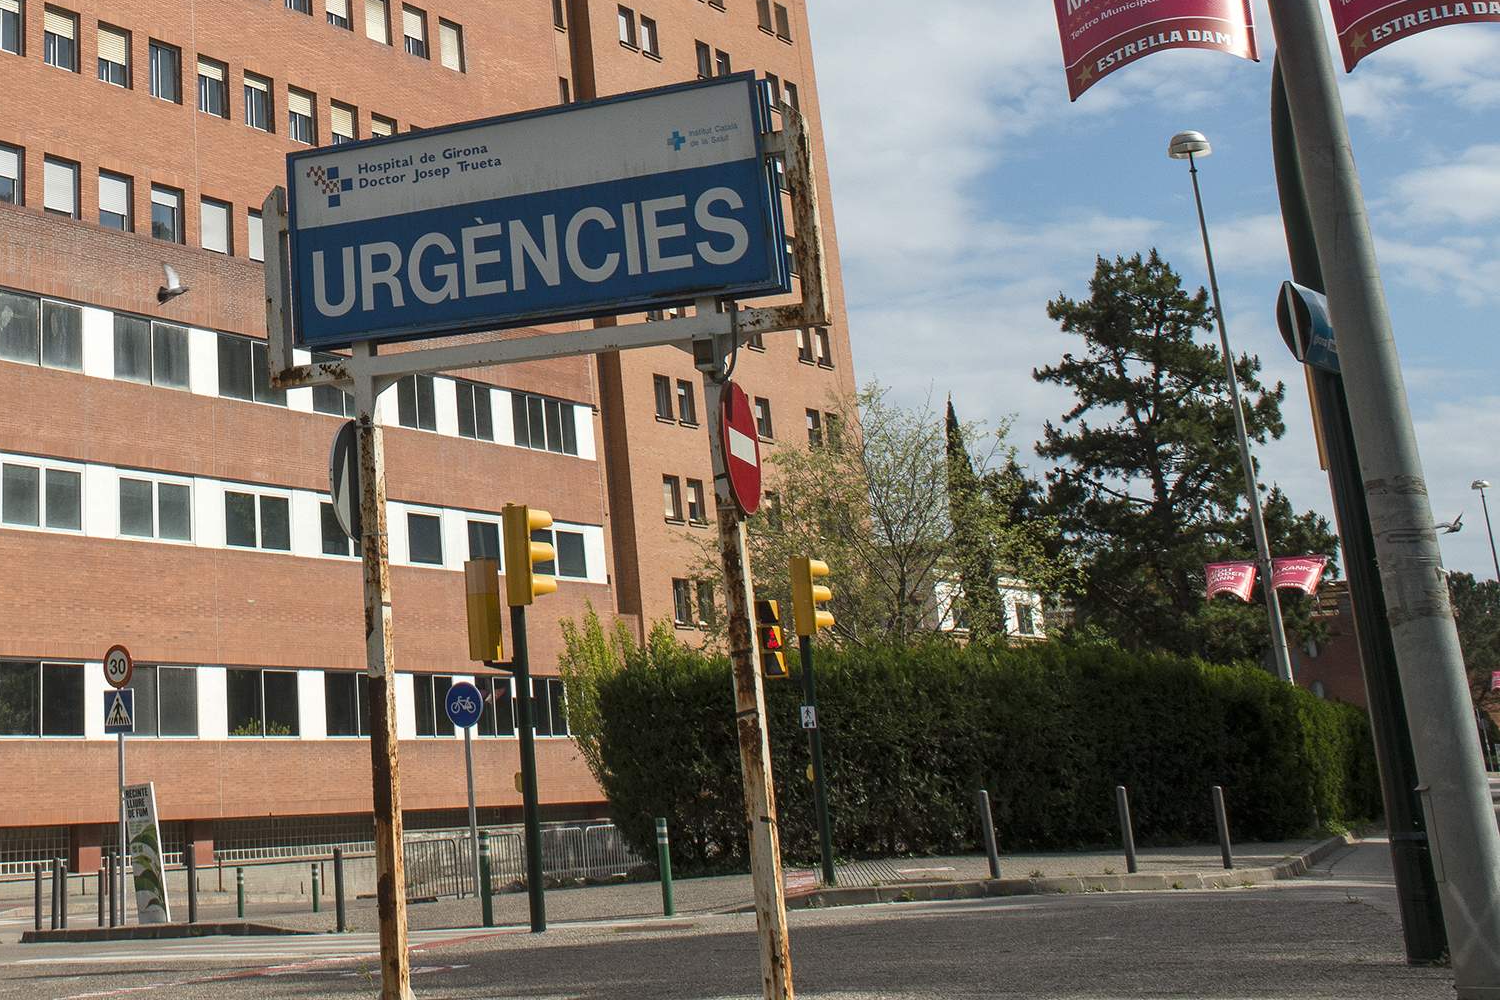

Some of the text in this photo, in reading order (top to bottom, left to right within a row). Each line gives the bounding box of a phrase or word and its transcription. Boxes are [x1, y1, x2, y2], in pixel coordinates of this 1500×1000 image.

[1371, 1, 1500, 43] ESTRELLA DA
[1096, 28, 1235, 73] ESTRELLA DAM
[357, 145, 489, 175] Hospital de Girona
[359, 157, 502, 189] Doctor Josep Trueta
[312, 186, 750, 318] URGÈNCIES
[109, 658, 126, 675] 30
